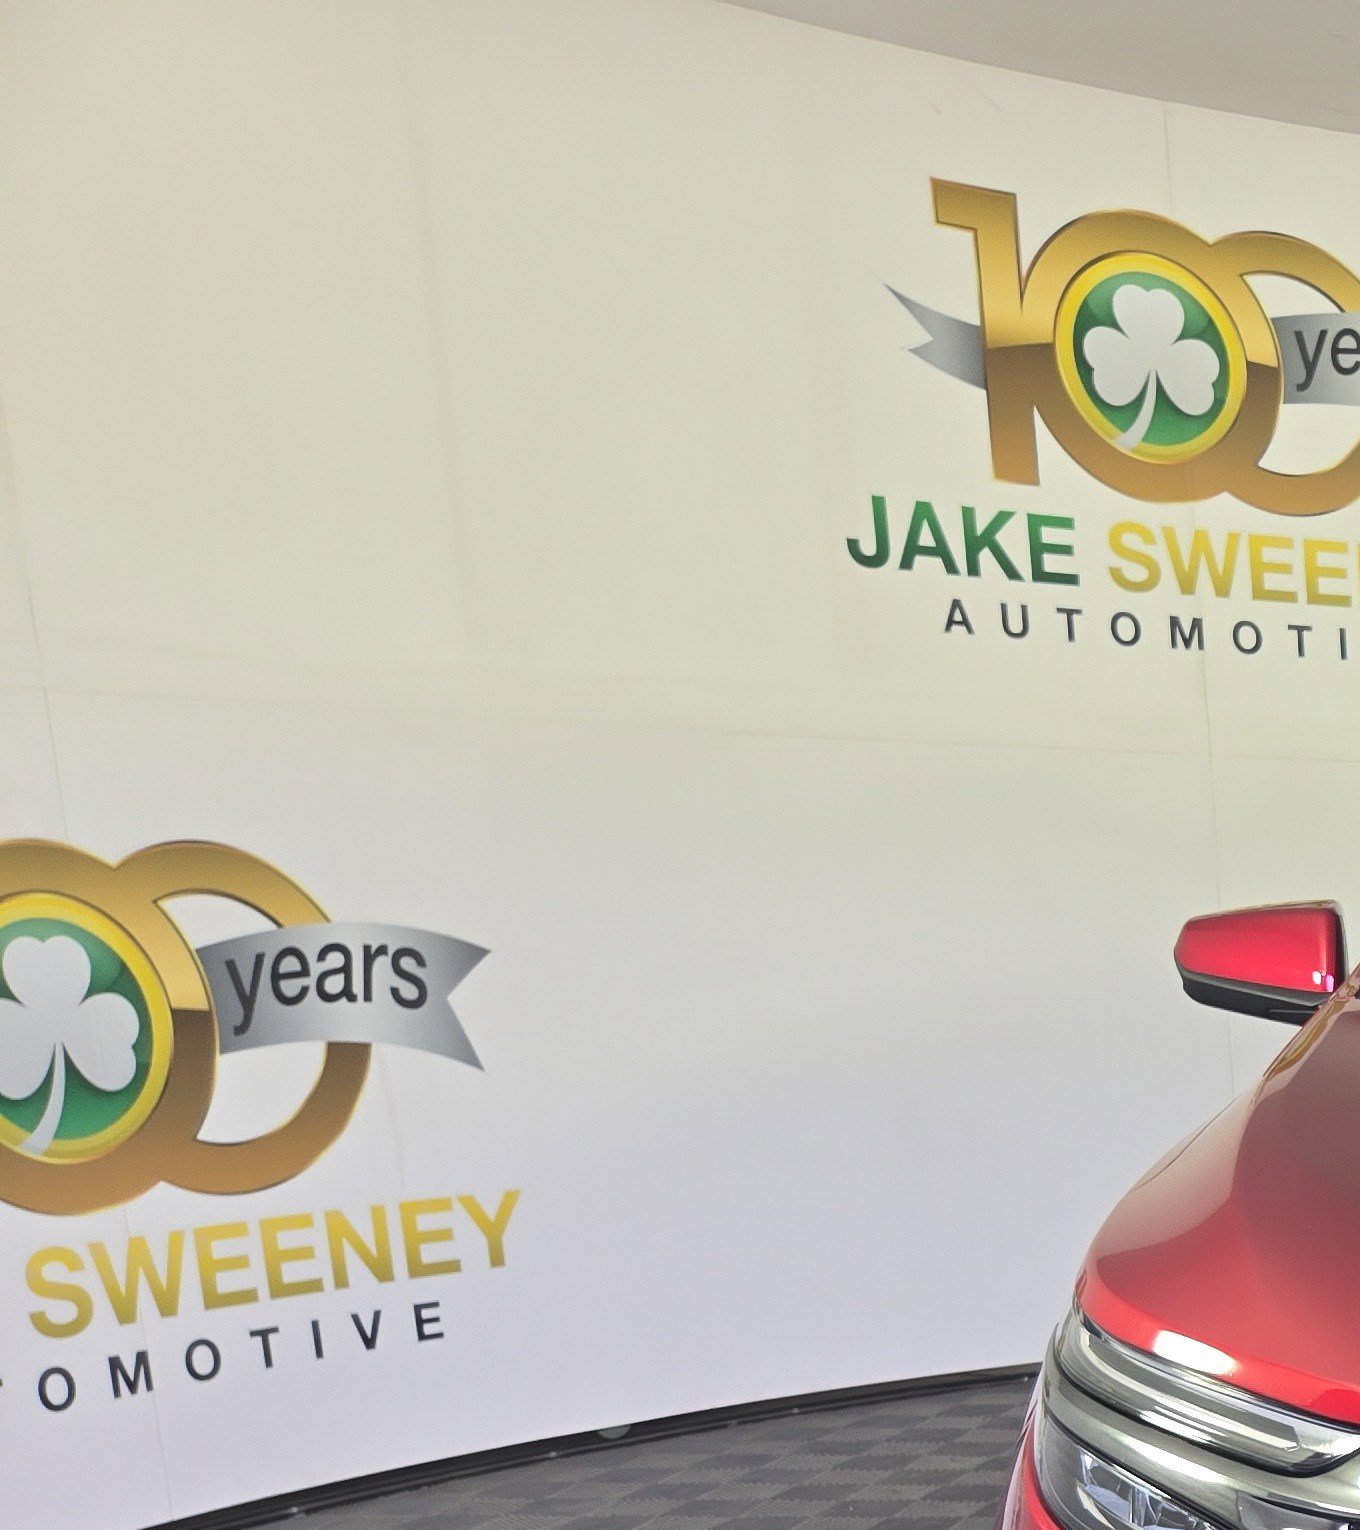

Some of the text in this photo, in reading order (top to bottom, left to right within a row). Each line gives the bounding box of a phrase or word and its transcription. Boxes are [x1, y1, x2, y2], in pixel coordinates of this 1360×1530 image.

[846, 494, 1080, 587] JAKE
[224, 942, 428, 1035] years
[24, 1190, 522, 1339] SWEENEY
[0, 1301, 445, 1412] OMOTIVE
